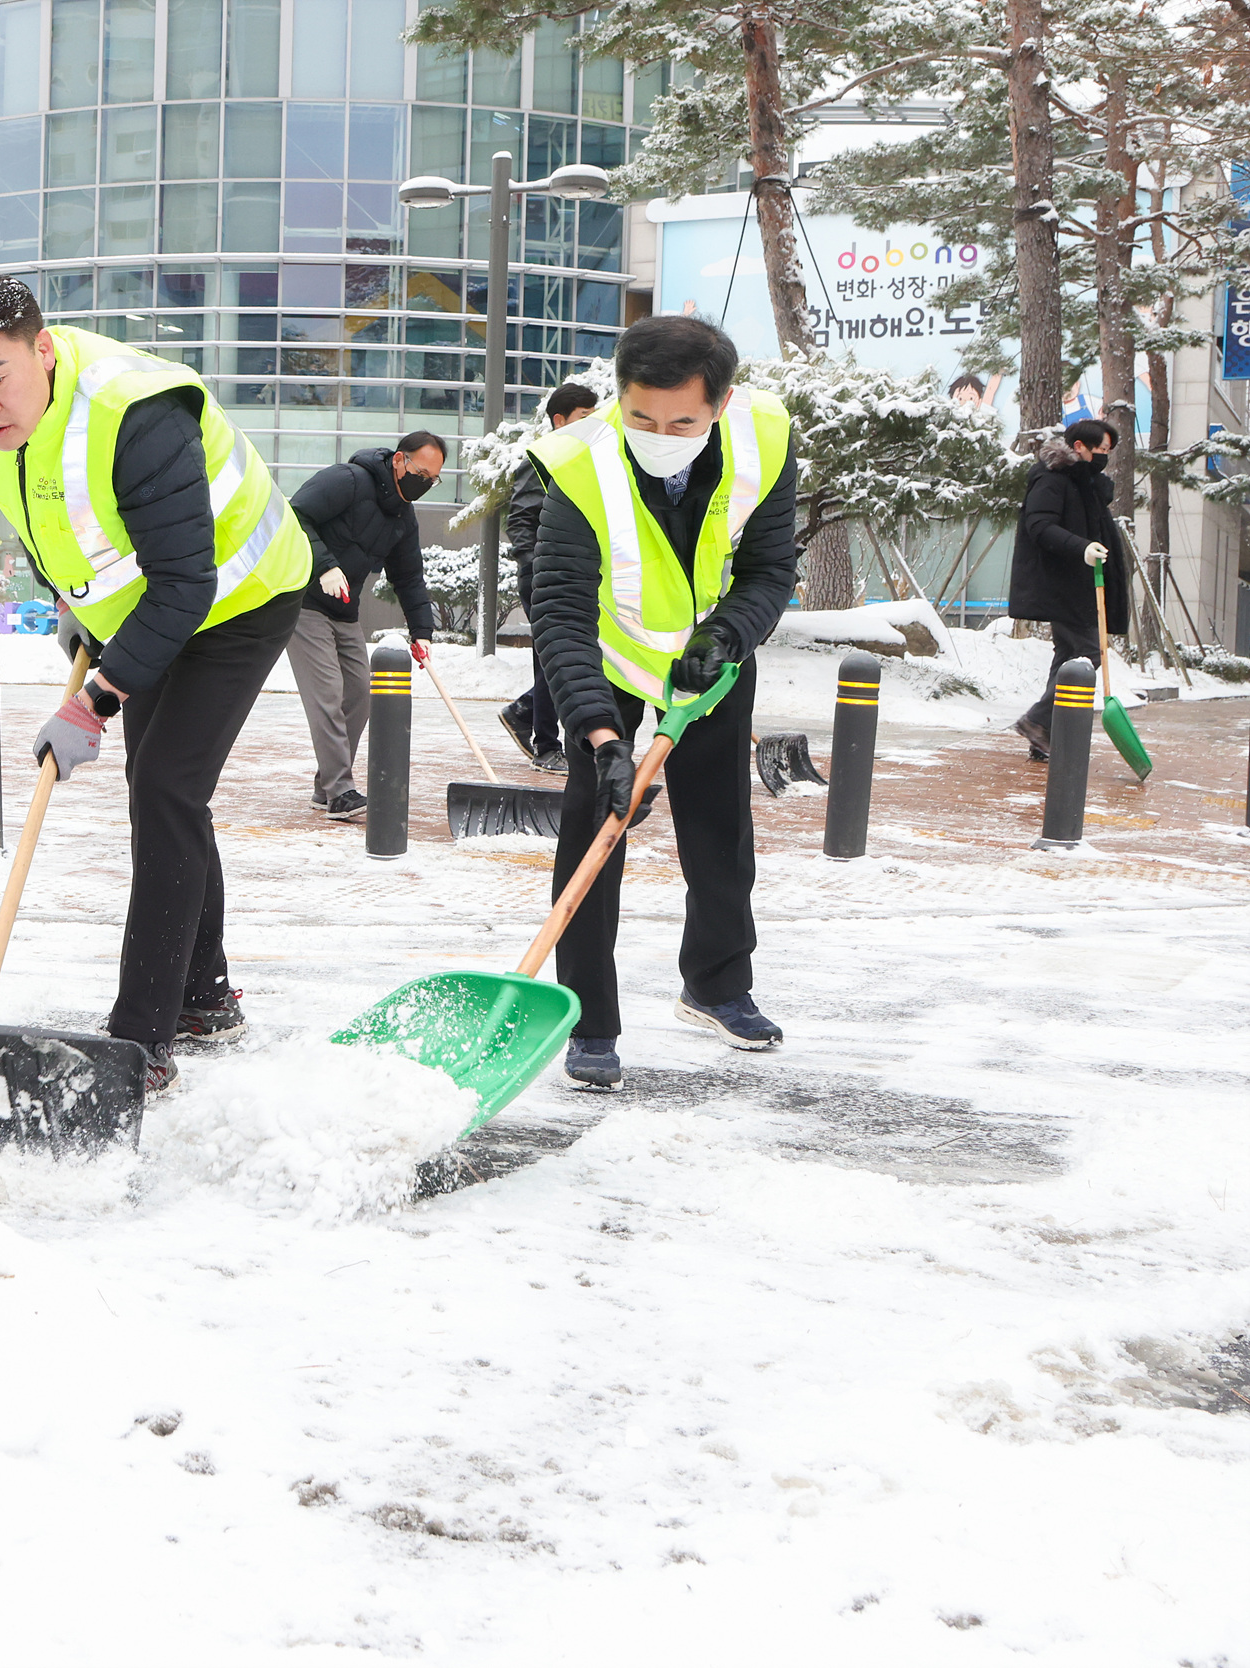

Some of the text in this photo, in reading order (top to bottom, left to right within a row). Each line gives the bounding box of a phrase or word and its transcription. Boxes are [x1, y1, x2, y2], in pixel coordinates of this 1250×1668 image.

[838, 239, 978, 274] dobong
[836, 274, 955, 302] 변화·성장·미
[808, 305, 934, 348] 함께해요!
[51, 491, 65, 501] 도봉
